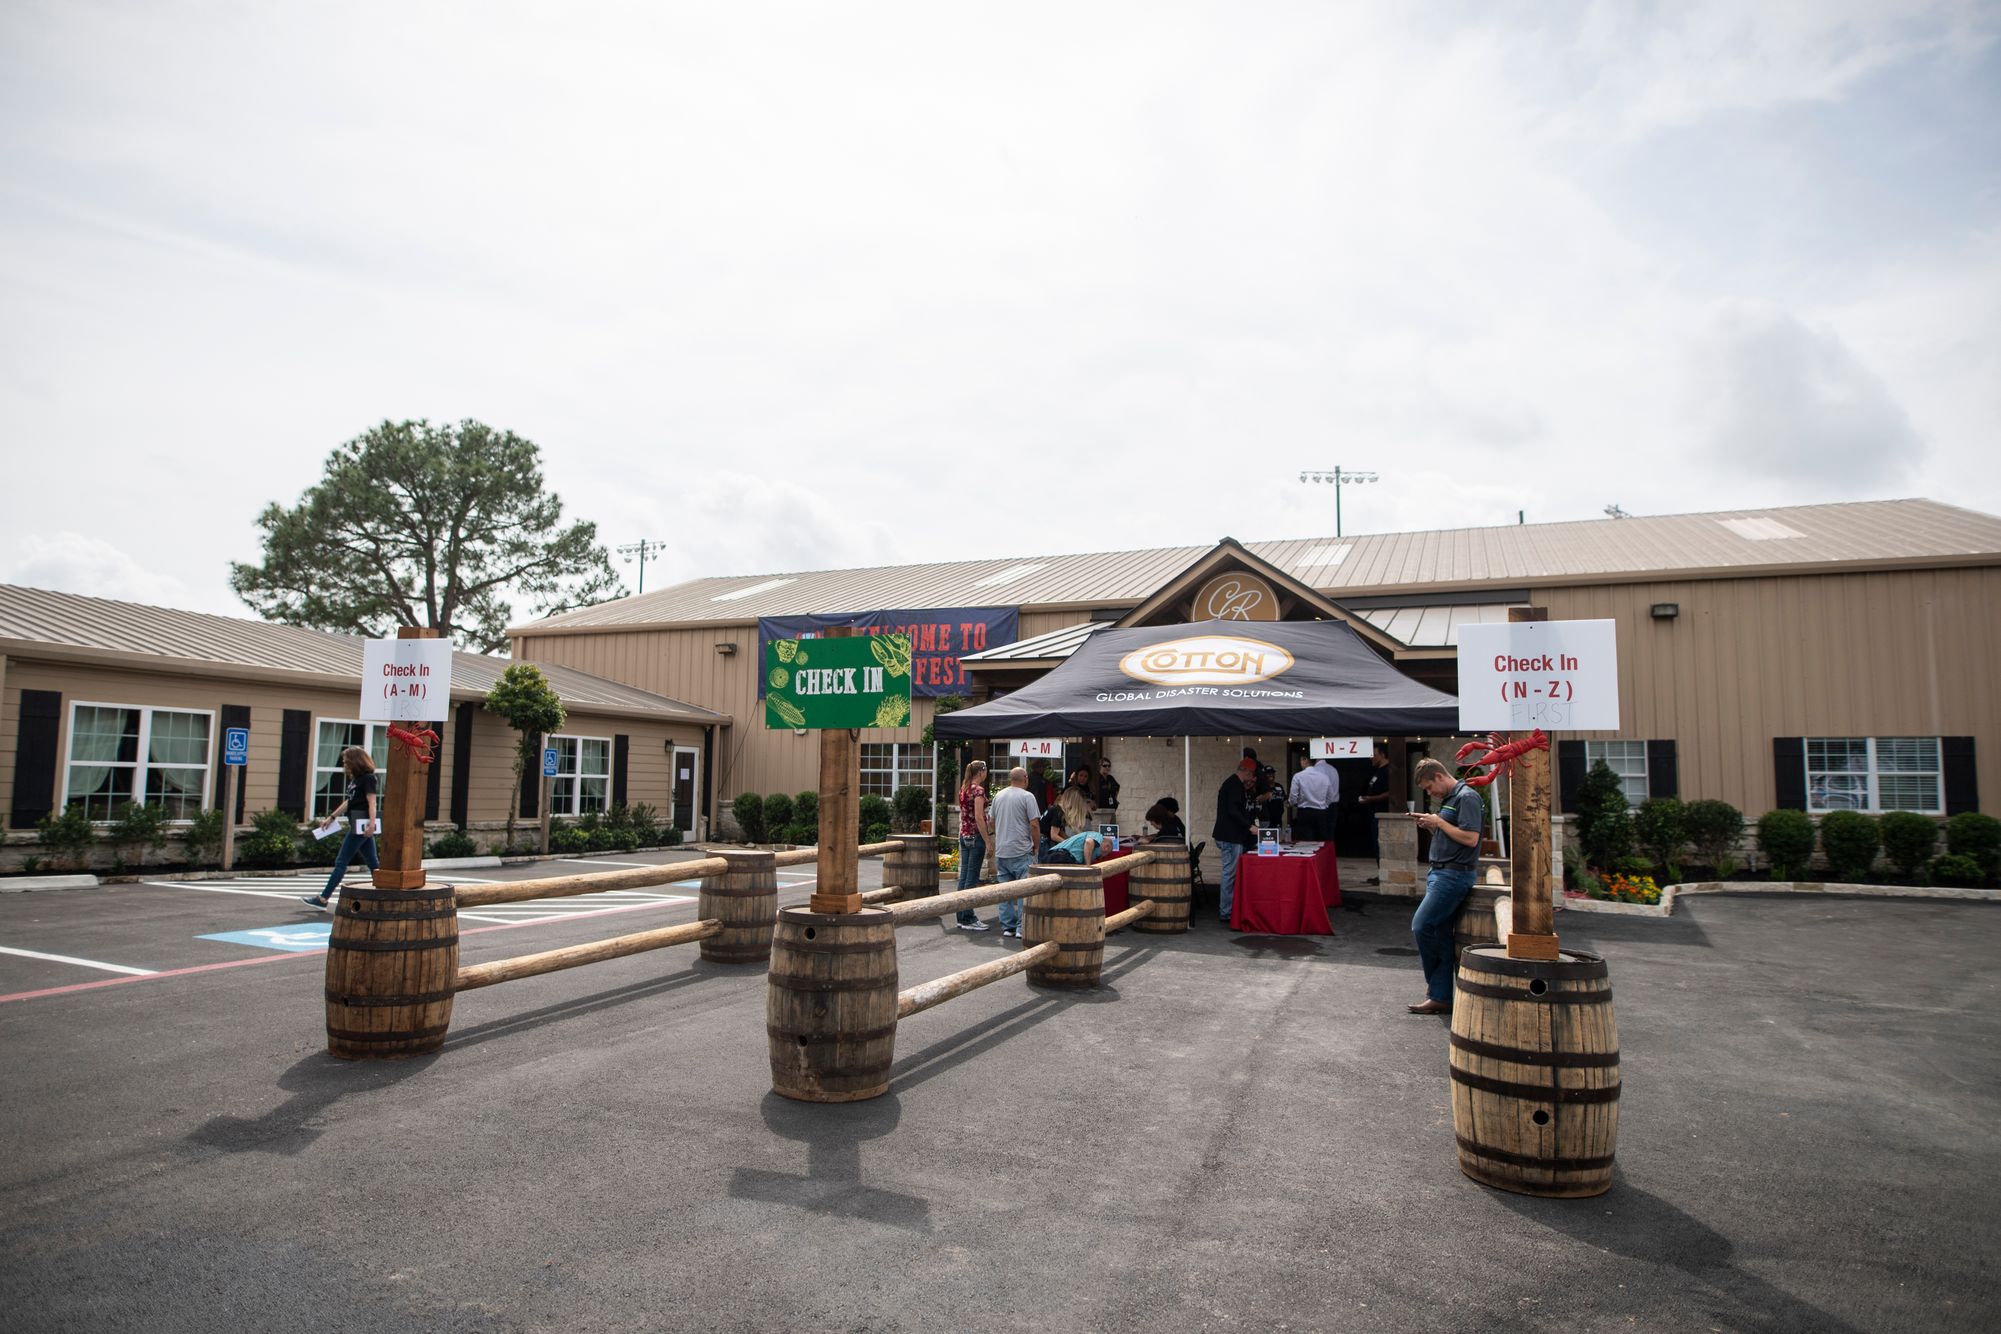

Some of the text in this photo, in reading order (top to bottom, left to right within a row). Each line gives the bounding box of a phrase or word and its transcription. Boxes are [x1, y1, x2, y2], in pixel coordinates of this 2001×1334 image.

[960, 622, 986, 651] TO
[383, 663, 430, 677] Check In
[1140, 649, 1265, 675] COTTON
[1494, 653, 1578, 672] Check In
[795, 666, 884, 695] CHECK IN
[1096, 687, 1304, 702] GLOBAL DISASTER SOLUTIONS
[1511, 701, 1579, 726] FIRST
